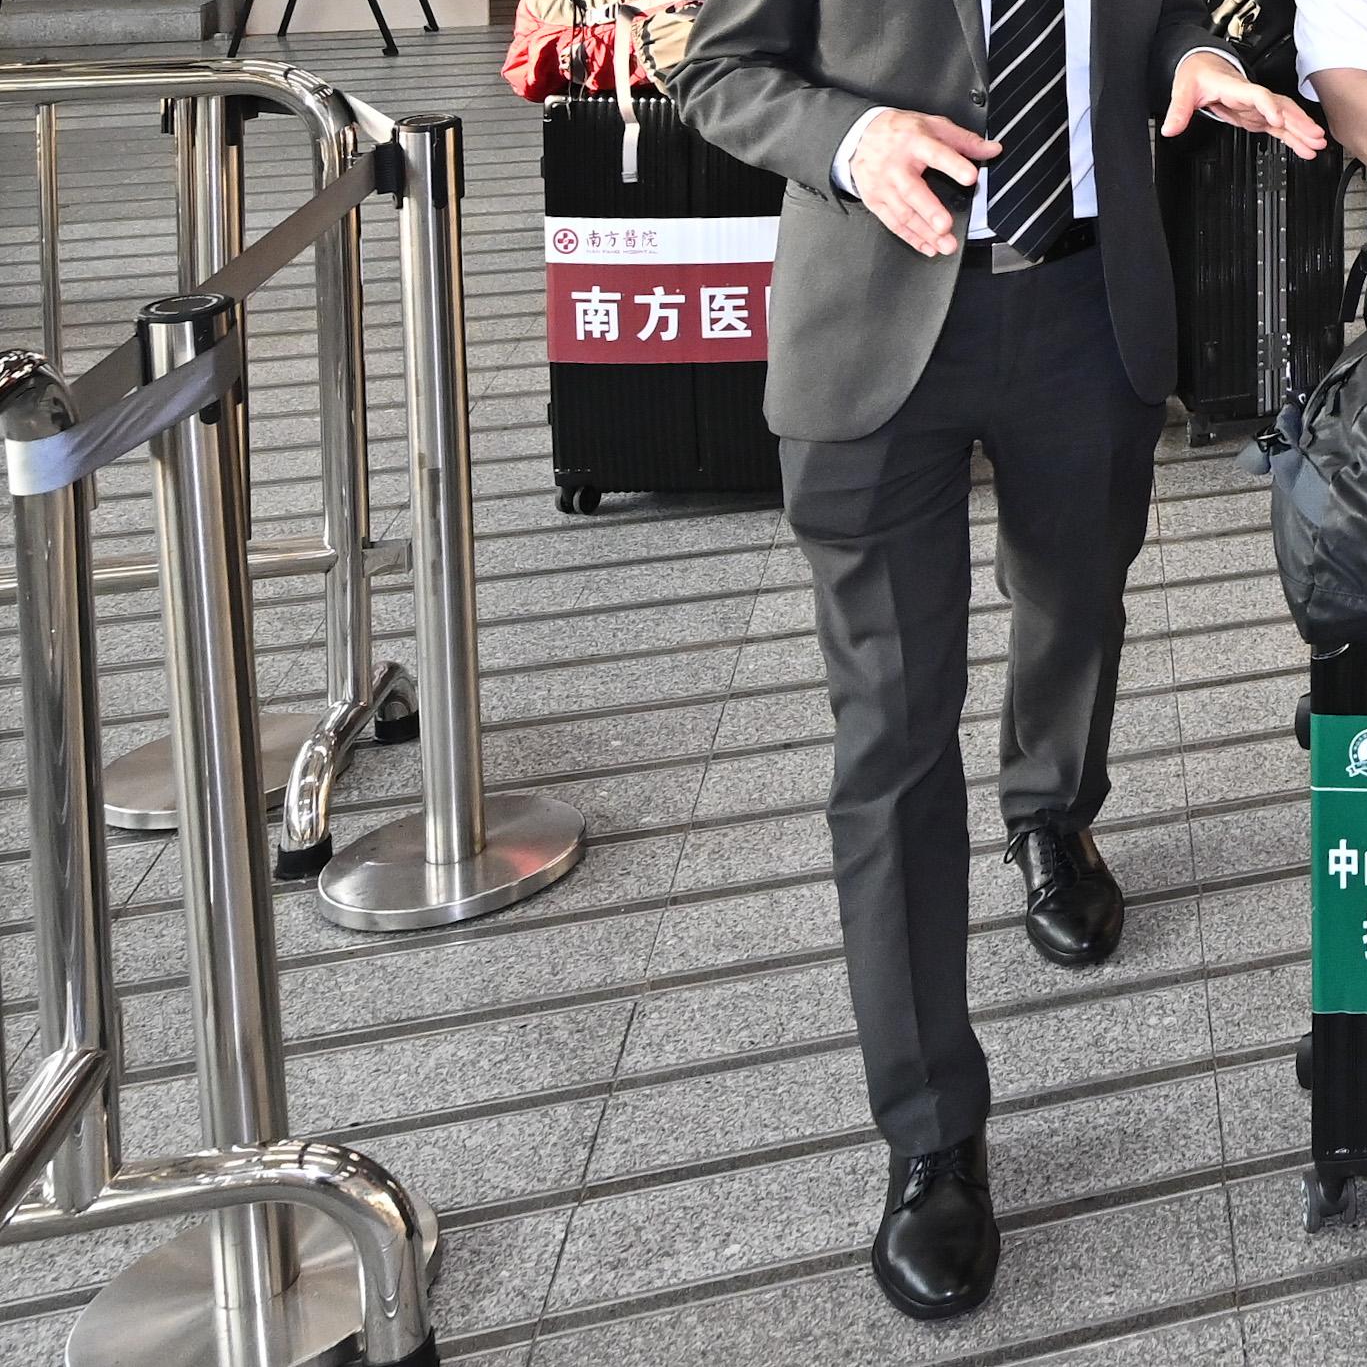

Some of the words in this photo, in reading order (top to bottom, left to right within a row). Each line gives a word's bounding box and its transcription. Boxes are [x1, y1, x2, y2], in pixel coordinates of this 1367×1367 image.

[587, 229, 658, 248] 南方醫院
[571, 285, 771, 341] 南方医
